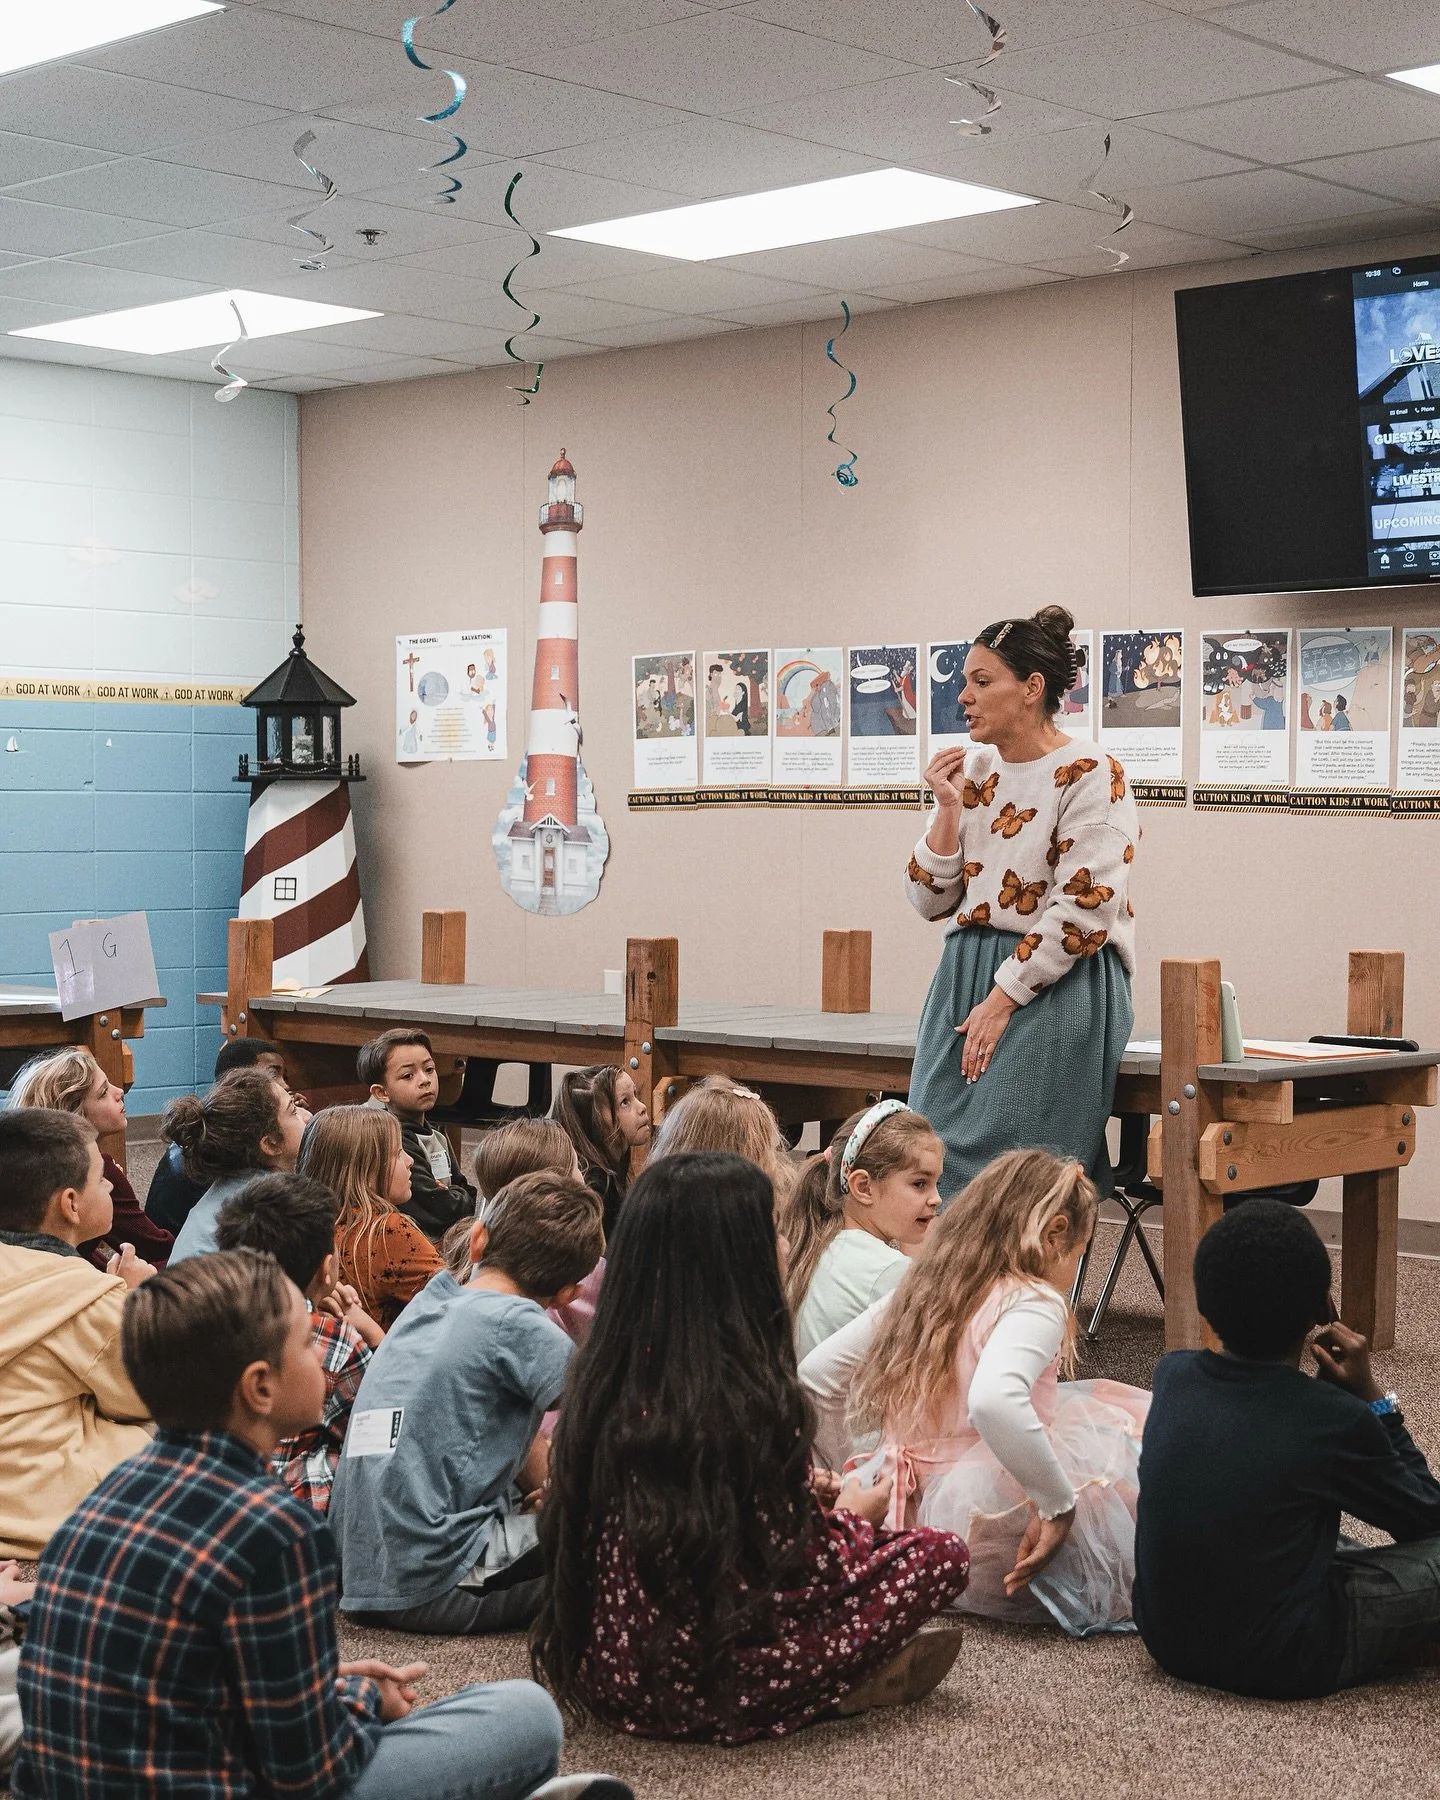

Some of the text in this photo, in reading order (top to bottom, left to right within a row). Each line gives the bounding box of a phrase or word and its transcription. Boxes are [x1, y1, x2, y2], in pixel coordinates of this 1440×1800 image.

[1365, 270, 1381, 278] 10:38
[1374, 430, 1423, 445] GUESTS
[16, 683, 80, 696] GOD AT WORK
[97, 686, 159, 699] GOD AT WORK
[174, 689, 234, 701] GOD AT WORK
[696, 790, 768, 801] CAUTION KIDS AT WORK
[768, 792, 797, 800] CAUTION
[798, 792, 813, 800] KIDS
[844, 792, 872, 801] CAUTION
[874, 792, 889, 800] KIDS
[900, 792, 919, 800] WORK
[1150, 789, 1159, 797] AT
[1161, 789, 1185, 798] WORK
[1194, 793, 1288, 804] CAUTION KIDS AT WORK
[628, 795, 654, 804] CAUTION
[654, 795, 670, 803] KIDS
[678, 794, 695, 802] WORK
[1290, 797, 1389, 807] CAUTION KIDS AT WORK
[1392, 800, 1432, 809] CAUTION
[59, 932, 117, 983] 1 G
